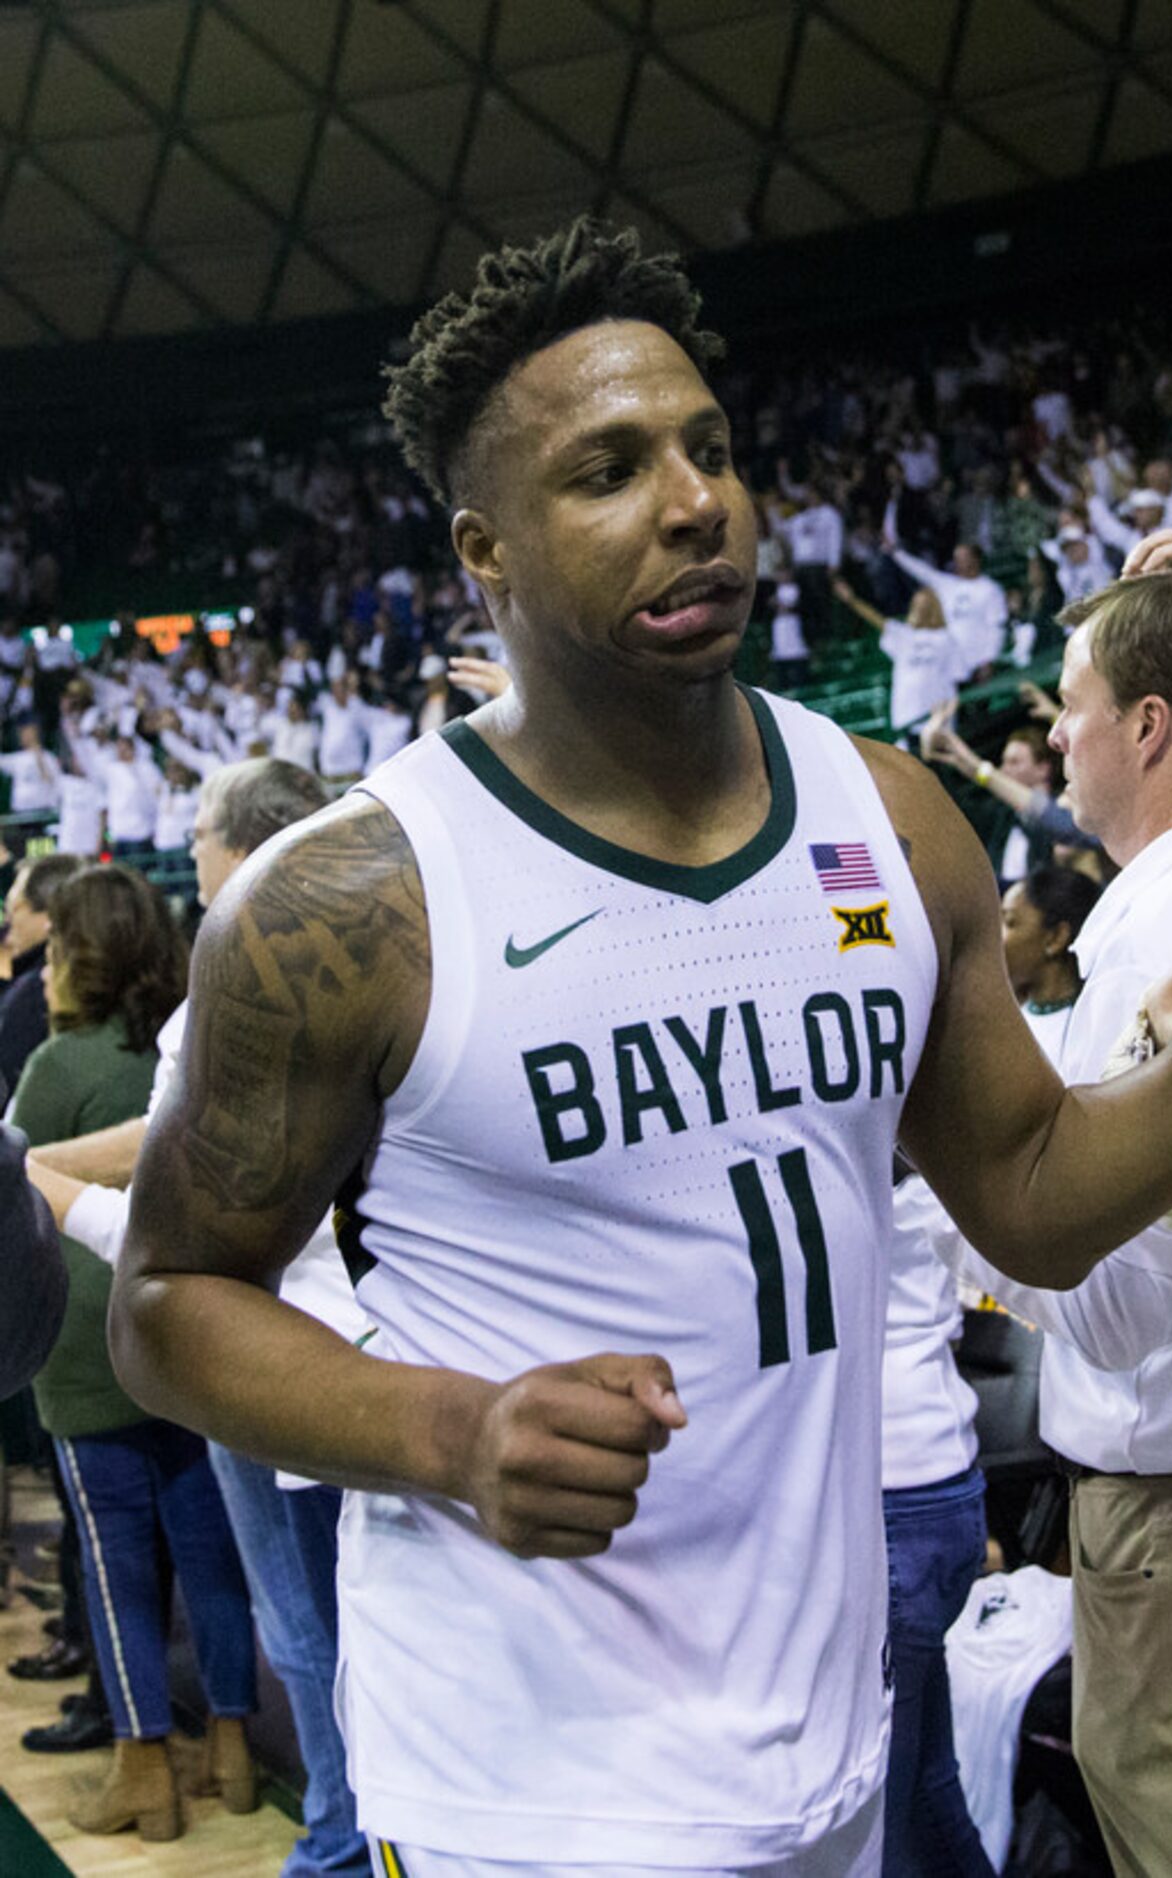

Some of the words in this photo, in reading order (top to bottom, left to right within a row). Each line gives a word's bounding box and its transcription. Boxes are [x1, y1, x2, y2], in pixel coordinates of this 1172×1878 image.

[833, 903, 894, 949] XII
[521, 988, 906, 1163] BAYLOR
[727, 1146, 838, 1369] 11
